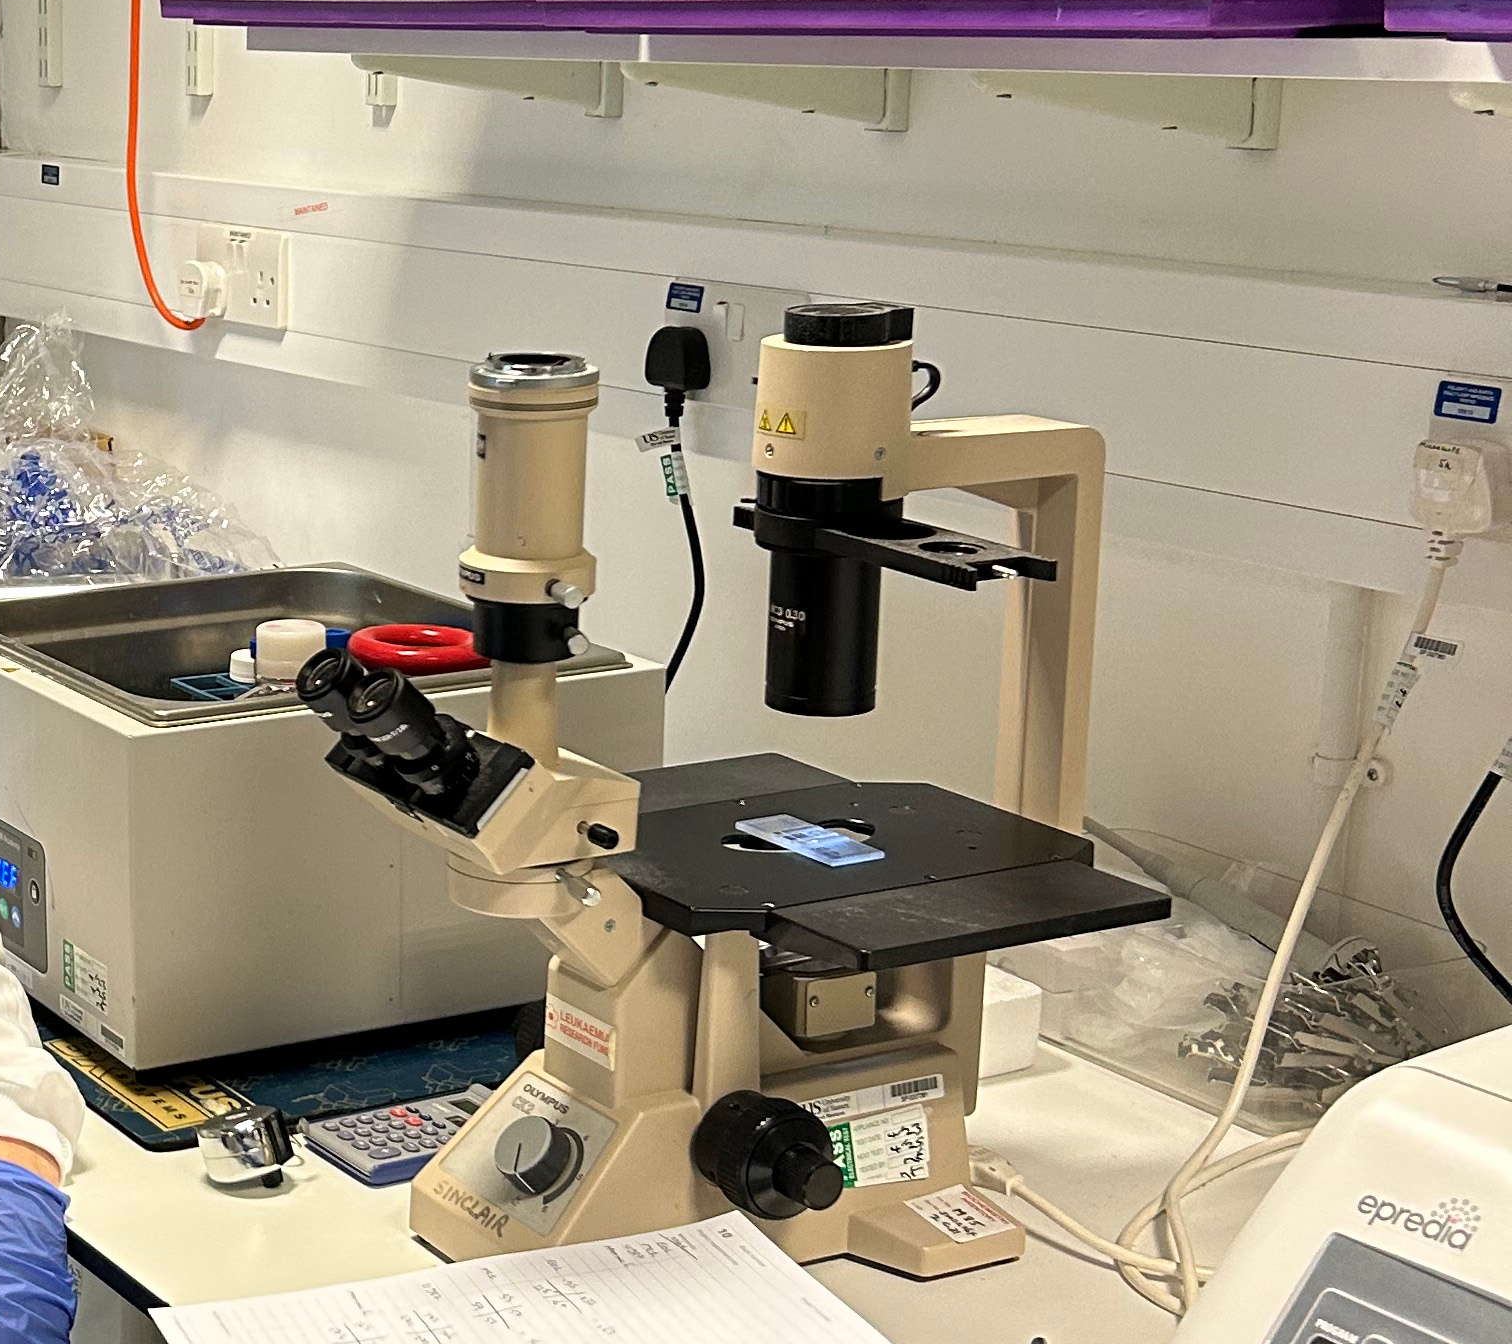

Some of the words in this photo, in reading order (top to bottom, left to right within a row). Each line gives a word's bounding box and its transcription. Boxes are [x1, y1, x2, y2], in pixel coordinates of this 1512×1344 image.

[512, 1095, 536, 1116] CK2
[523, 1083, 570, 1115] OLYMPUS
[830, 1129, 849, 1181] ASS
[433, 1180, 510, 1240] SINCLAIR
[1357, 1194, 1473, 1251] epredia
[718, 1228, 733, 1239] 10
[1314, 1317, 1360, 1344] PROGRAM
